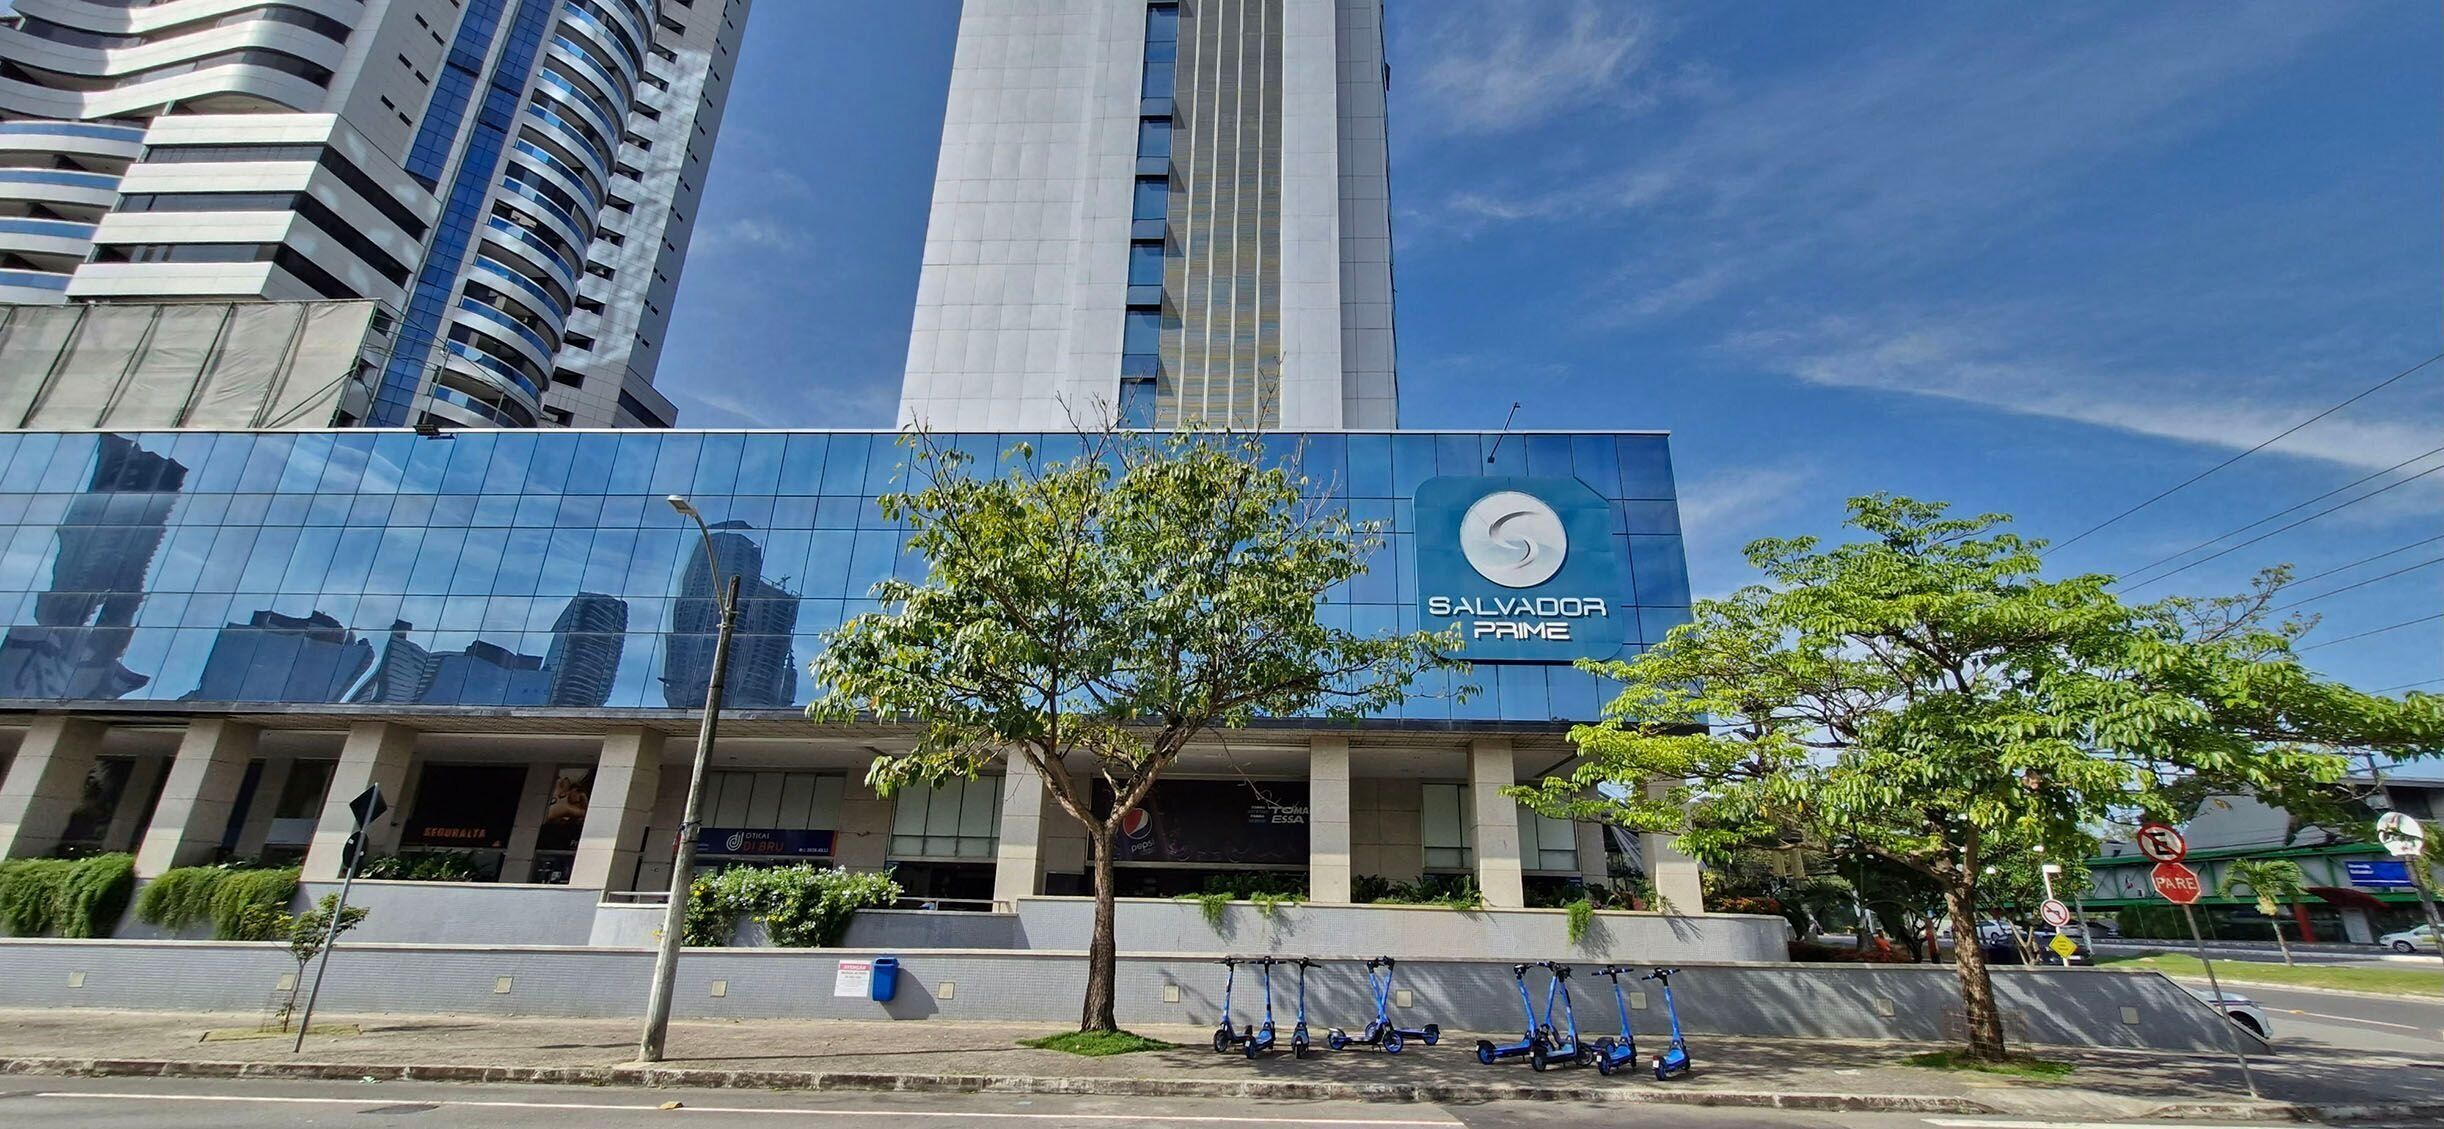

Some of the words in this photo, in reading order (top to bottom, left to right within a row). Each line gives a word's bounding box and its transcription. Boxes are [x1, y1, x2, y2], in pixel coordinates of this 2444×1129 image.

[1428, 595, 1608, 617] SALVADOR
[1473, 621, 1571, 640] PRIME
[1271, 815, 1305, 824] ESSA
[758, 841, 785, 852] BRU
[2155, 877, 2197, 890] PARE
